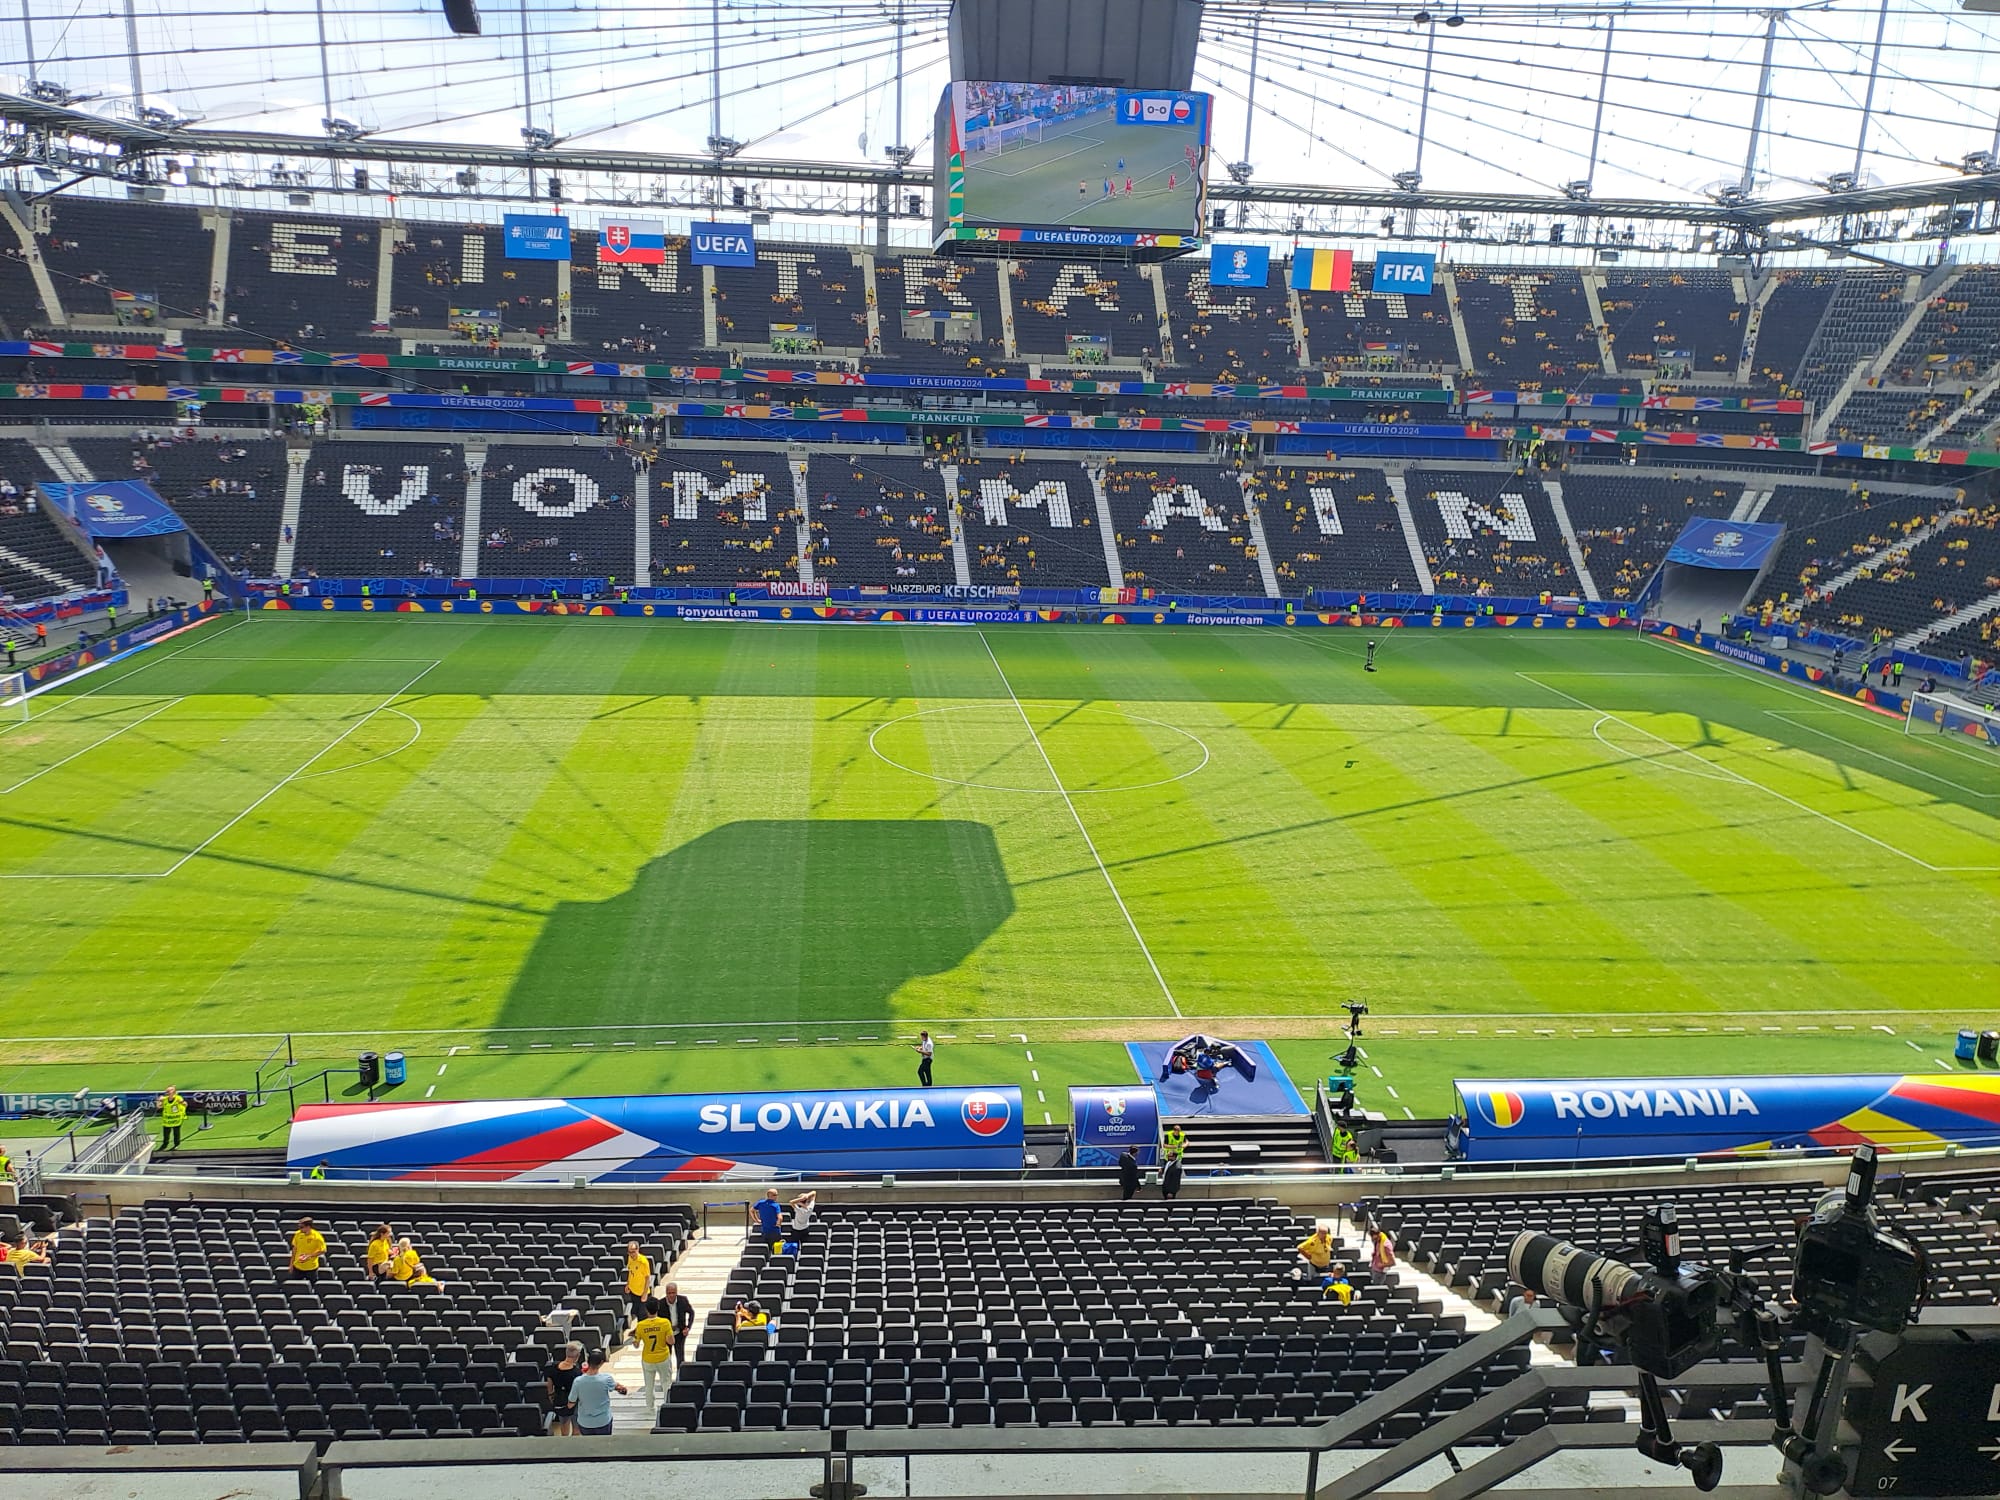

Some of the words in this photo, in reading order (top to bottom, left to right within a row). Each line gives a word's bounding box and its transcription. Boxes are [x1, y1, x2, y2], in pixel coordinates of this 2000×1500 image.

[696, 236, 749, 254] UEFA
[1382, 264, 1426, 283] FIFA
[439, 359, 519, 370] FRANKFURT
[1351, 390, 1422, 400] FRANKFURT
[911, 413, 981, 423] FRANKFURT
[770, 582, 828, 596] RODALBEN
[890, 584, 941, 594] HARZBURG
[944, 586, 996, 598] KETSCH
[677, 607, 759, 618] #onyourteam
[1187, 614, 1264, 626] #onyourteam
[1714, 640, 1766, 666] #onyourteam
[1550, 1088, 1760, 1119] ROMANIA
[698, 1098, 935, 1135] SLOVAKIA
[649, 1334, 657, 1352] 7
[1890, 1383, 1933, 1422] K
[1877, 1476, 1899, 1490] 07
